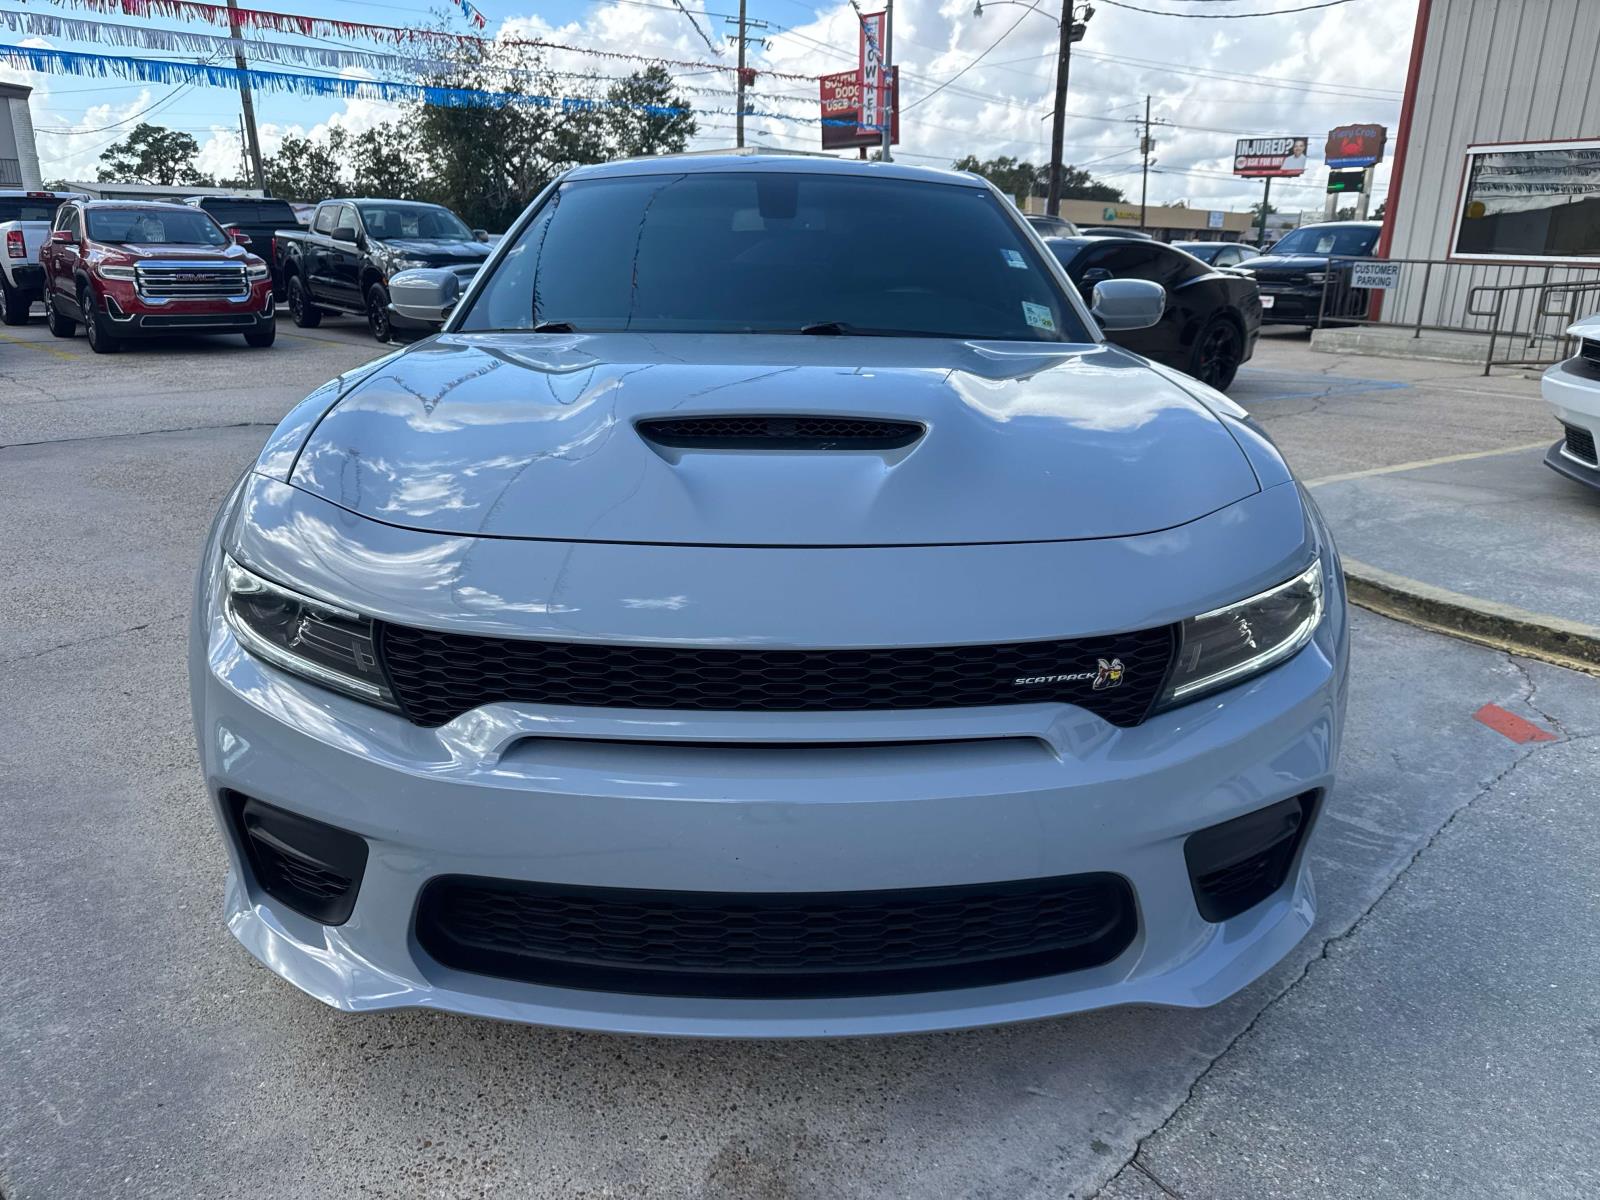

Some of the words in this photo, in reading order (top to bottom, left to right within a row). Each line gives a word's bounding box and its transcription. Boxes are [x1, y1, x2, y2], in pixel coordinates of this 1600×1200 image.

[1237, 139, 1295, 155] INJURED?
[1354, 264, 1398, 275] CUSTOMER
[1357, 276, 1391, 286] PARKING
[1015, 675, 1056, 685] SCAT
[1057, 671, 1097, 682] PACK
